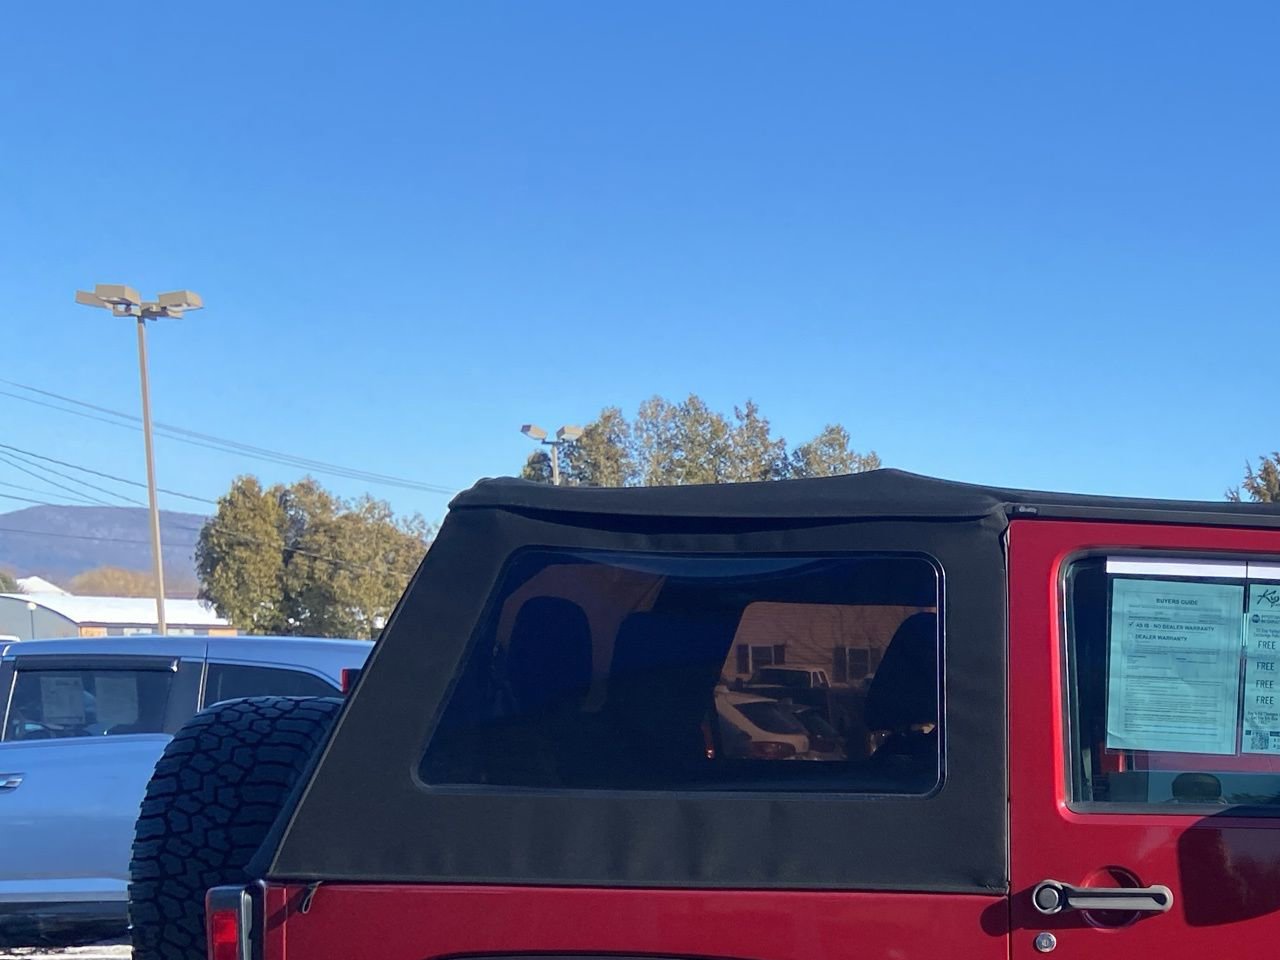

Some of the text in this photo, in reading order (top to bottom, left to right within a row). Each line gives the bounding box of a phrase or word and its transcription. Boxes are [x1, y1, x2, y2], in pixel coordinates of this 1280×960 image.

[1257, 641, 1276, 650] FREE
[1256, 662, 1275, 671] FREE
[1255, 680, 1275, 689] FREE
[1256, 696, 1274, 705] FREE
